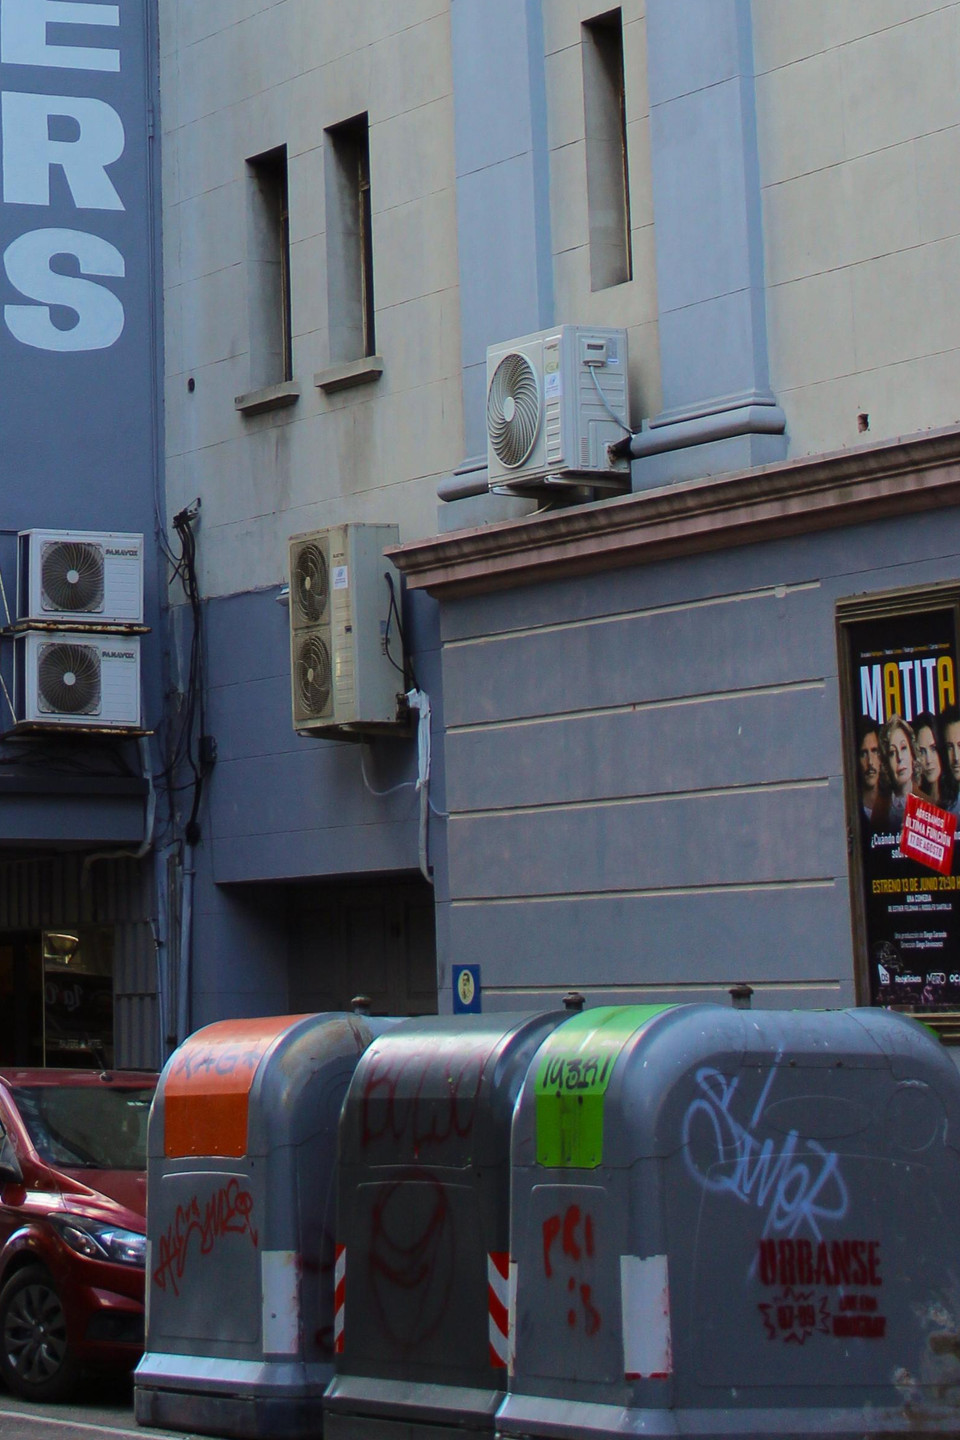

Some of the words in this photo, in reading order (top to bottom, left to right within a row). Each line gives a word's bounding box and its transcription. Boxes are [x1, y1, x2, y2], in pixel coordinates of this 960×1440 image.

[105, 546, 139, 557] PANAVOX
[860, 655, 955, 724] MATITA
[905, 813, 926, 835] ÚLTIMA
[927, 825, 952, 847] FUNCIÓN
[922, 840, 943, 858] AGOSTO
[872, 879, 900, 893] ESTRENO
[909, 878, 919, 891] DE
[920, 877, 937, 891] JUNIO
